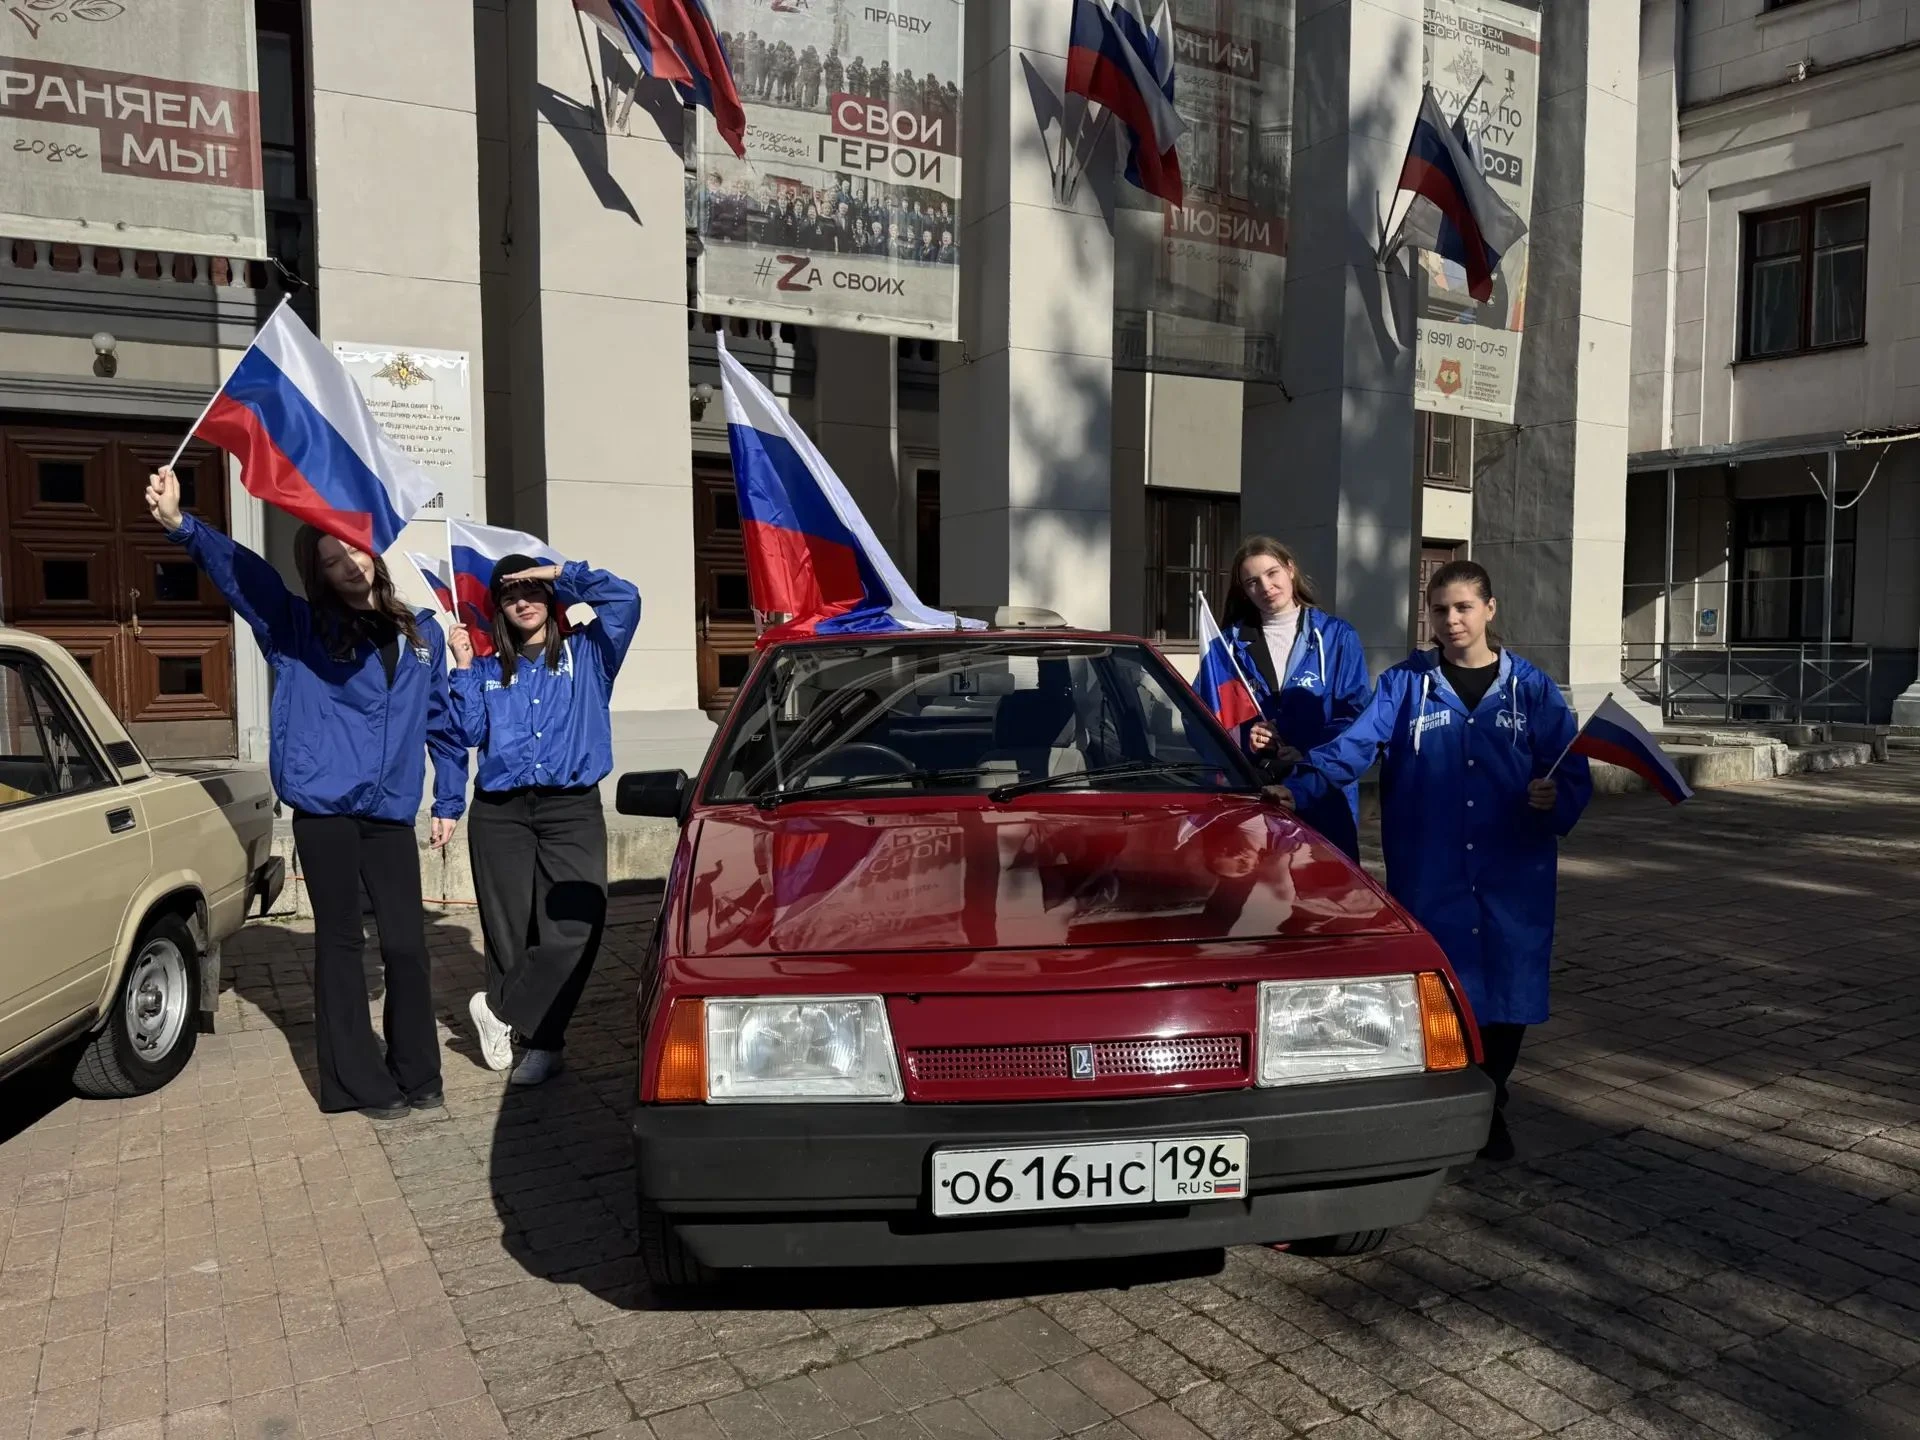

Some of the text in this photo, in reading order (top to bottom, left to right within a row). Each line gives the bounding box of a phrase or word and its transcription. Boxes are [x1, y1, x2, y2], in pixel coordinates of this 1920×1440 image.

[864, 7, 932, 33] ПРАВДУ
[1423, 7, 1504, 42] СТАНЬ ГЕРОЕМ
[1174, 29, 1255, 73] МНИМ
[1464, 34, 1511, 57] СТРАНЫ!
[837, 100, 942, 147] СВОИ
[1434, 86, 1522, 128] УЖБА ПО
[13, 139, 89, 162] года
[121, 133, 229, 178] МЫ!
[818, 134, 942, 183] ГЕРОИ
[1483, 153, 1507, 175] 00
[1170, 203, 1270, 247] ЛЮБИМ
[832, 271, 906, 297] СВОИХ
[1427, 329, 1453, 349] (991)
[1456, 336, 1508, 359] 801-07-51
[1159, 1144, 1231, 1180] 196
[1177, 1181, 1213, 1195] RUS
